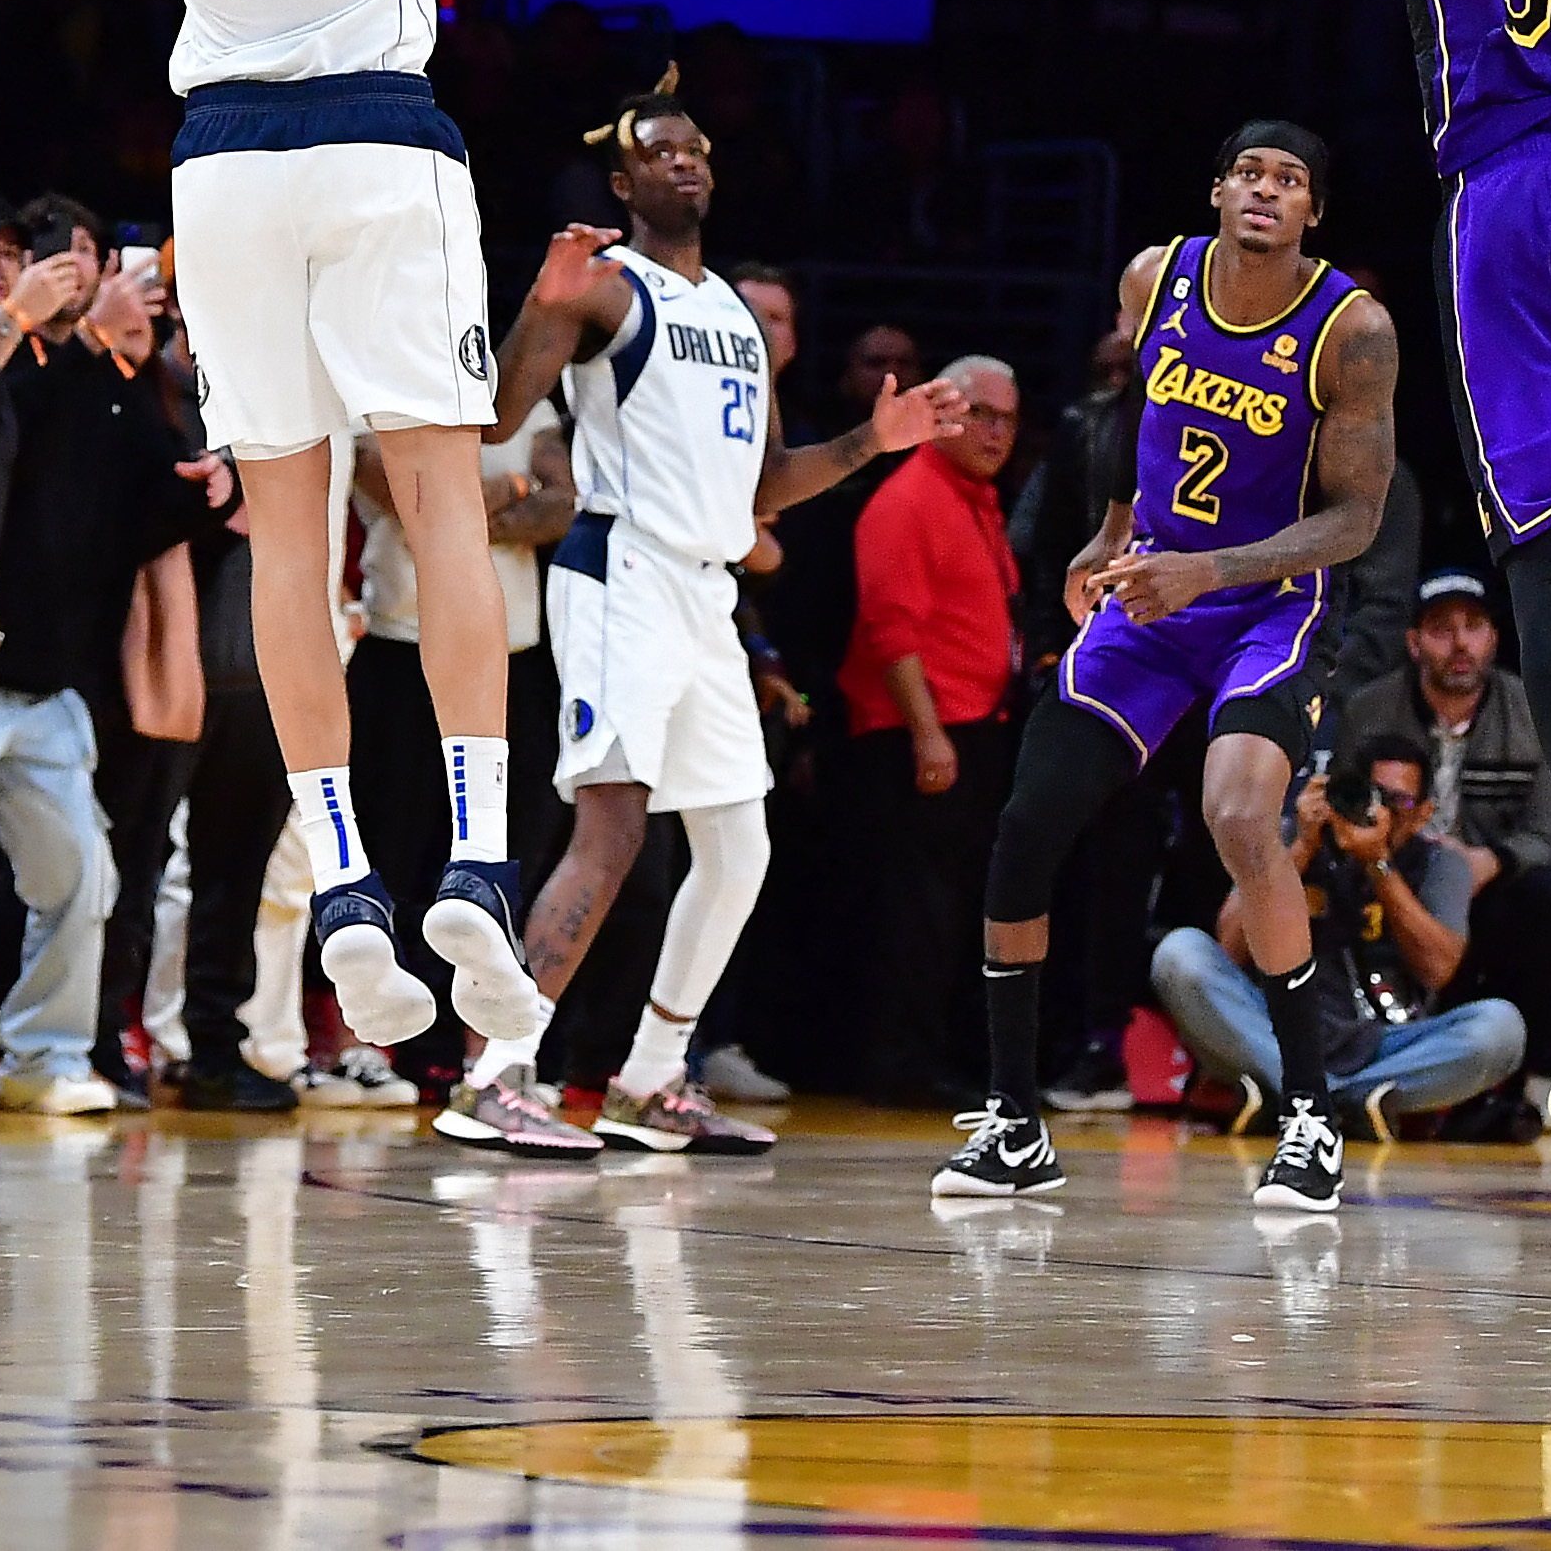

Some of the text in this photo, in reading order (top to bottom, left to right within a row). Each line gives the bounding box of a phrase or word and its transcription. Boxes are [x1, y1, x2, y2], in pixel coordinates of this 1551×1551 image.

[1173, 277, 1191, 299] 6
[666, 322, 759, 374] DALLAS
[720, 377, 757, 444] 25
[1146, 345, 1288, 436] LAKERS
[1172, 425, 1229, 525] 2
